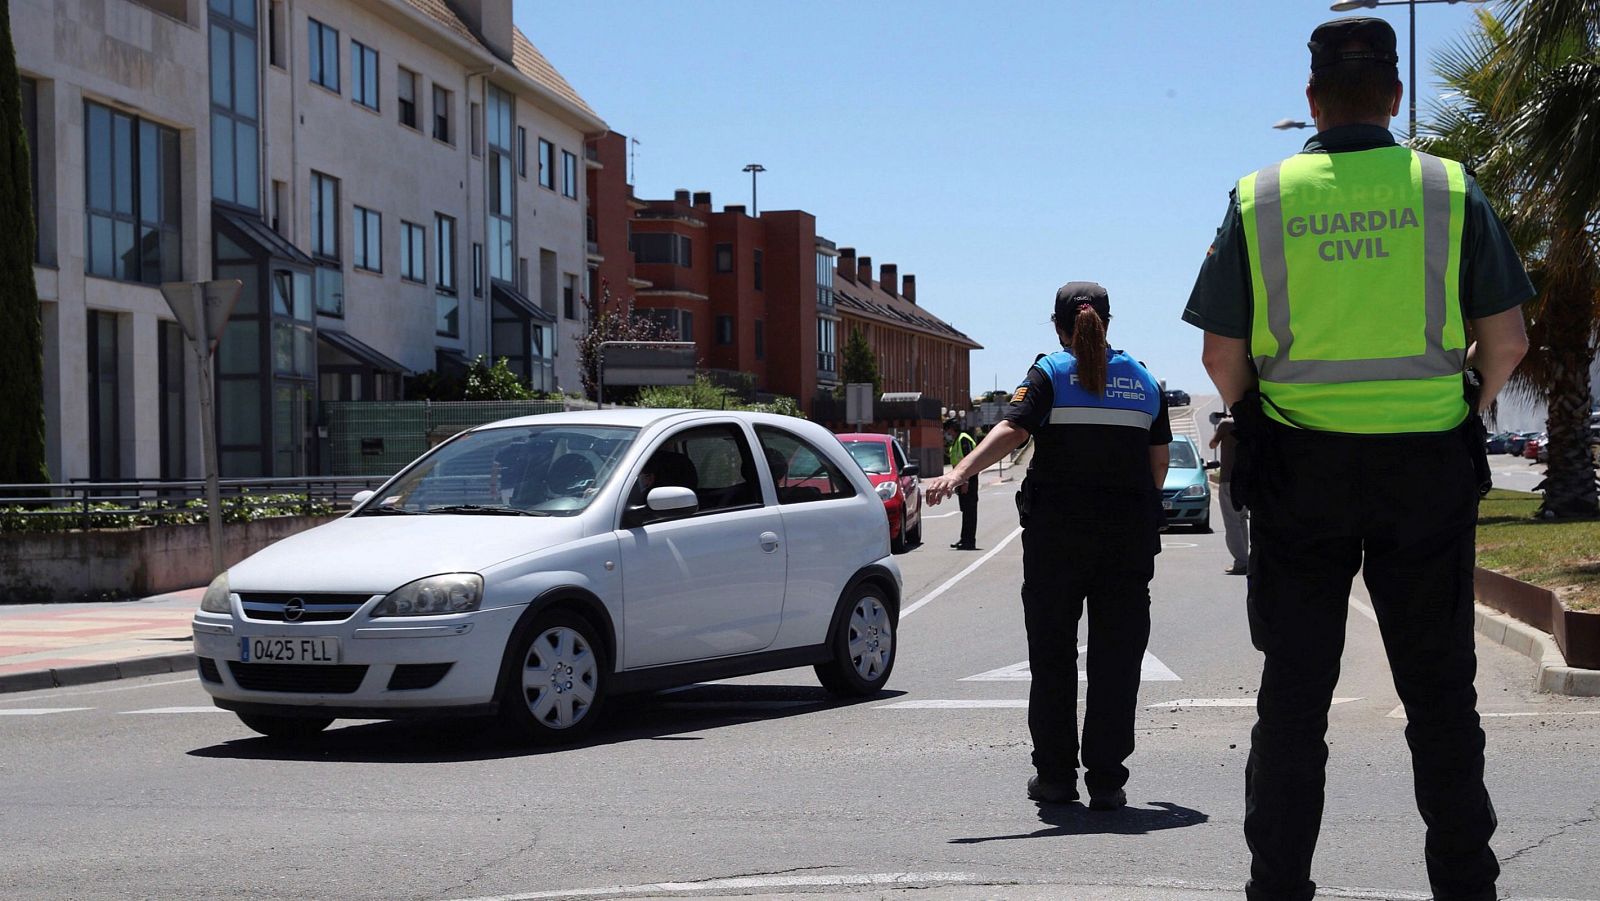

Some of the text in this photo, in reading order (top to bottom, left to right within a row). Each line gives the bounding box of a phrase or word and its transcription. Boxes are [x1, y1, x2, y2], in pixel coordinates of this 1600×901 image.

[1286, 207, 1419, 238] GUARDIA
[1318, 237, 1390, 262] CIVIL
[1069, 374, 1145, 391] PICIA
[1106, 389, 1146, 401] UTEBO
[254, 639, 332, 661] 0425 FLL
